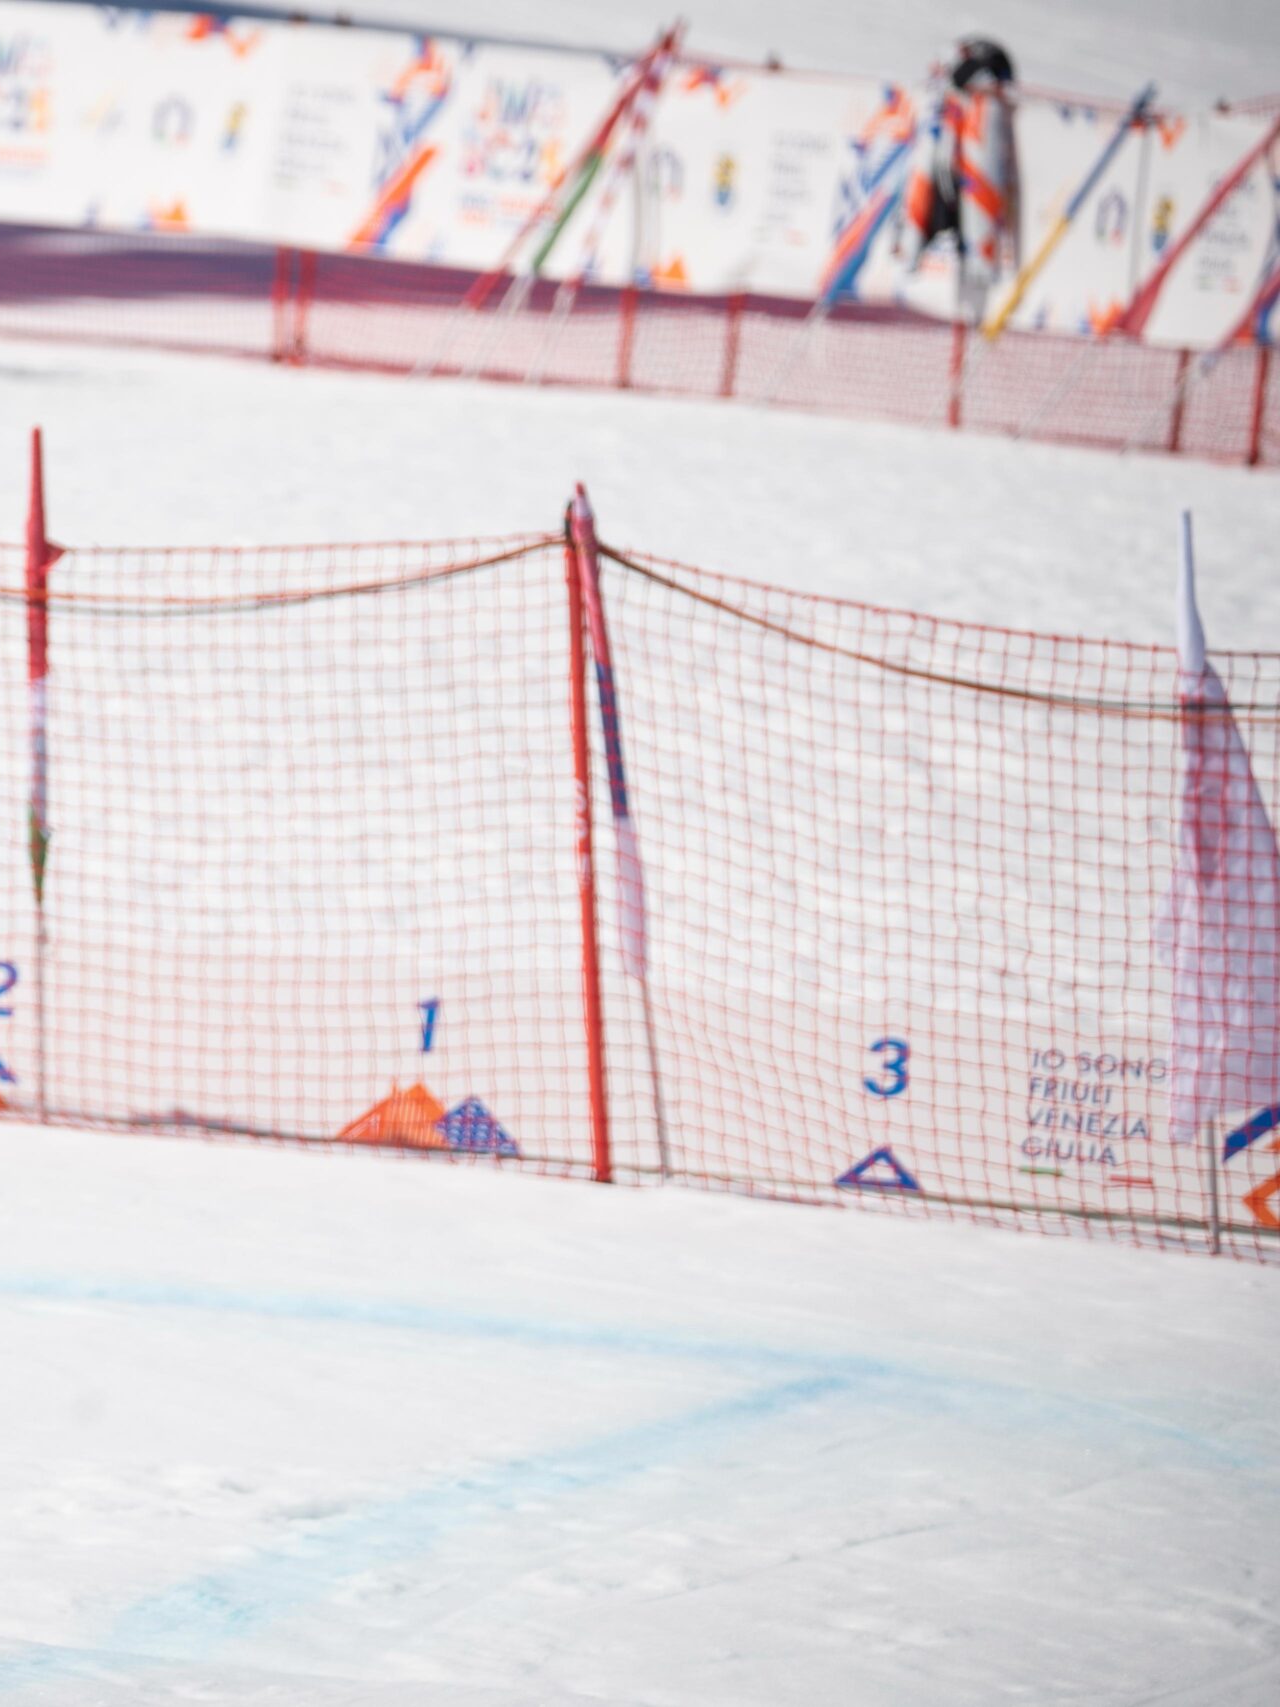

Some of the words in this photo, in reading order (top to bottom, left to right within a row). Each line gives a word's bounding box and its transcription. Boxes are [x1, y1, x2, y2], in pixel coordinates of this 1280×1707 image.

[419, 996, 439, 1052] 1
[863, 1038, 910, 1096] 3
[1032, 1050, 1065, 1071] IO
[1077, 1051, 1168, 1081] SONO
[1030, 1077, 1113, 1105] FRIULI
[1027, 1107, 1149, 1141] VENEZIA
[1021, 1135, 1117, 1167] GIULIA
